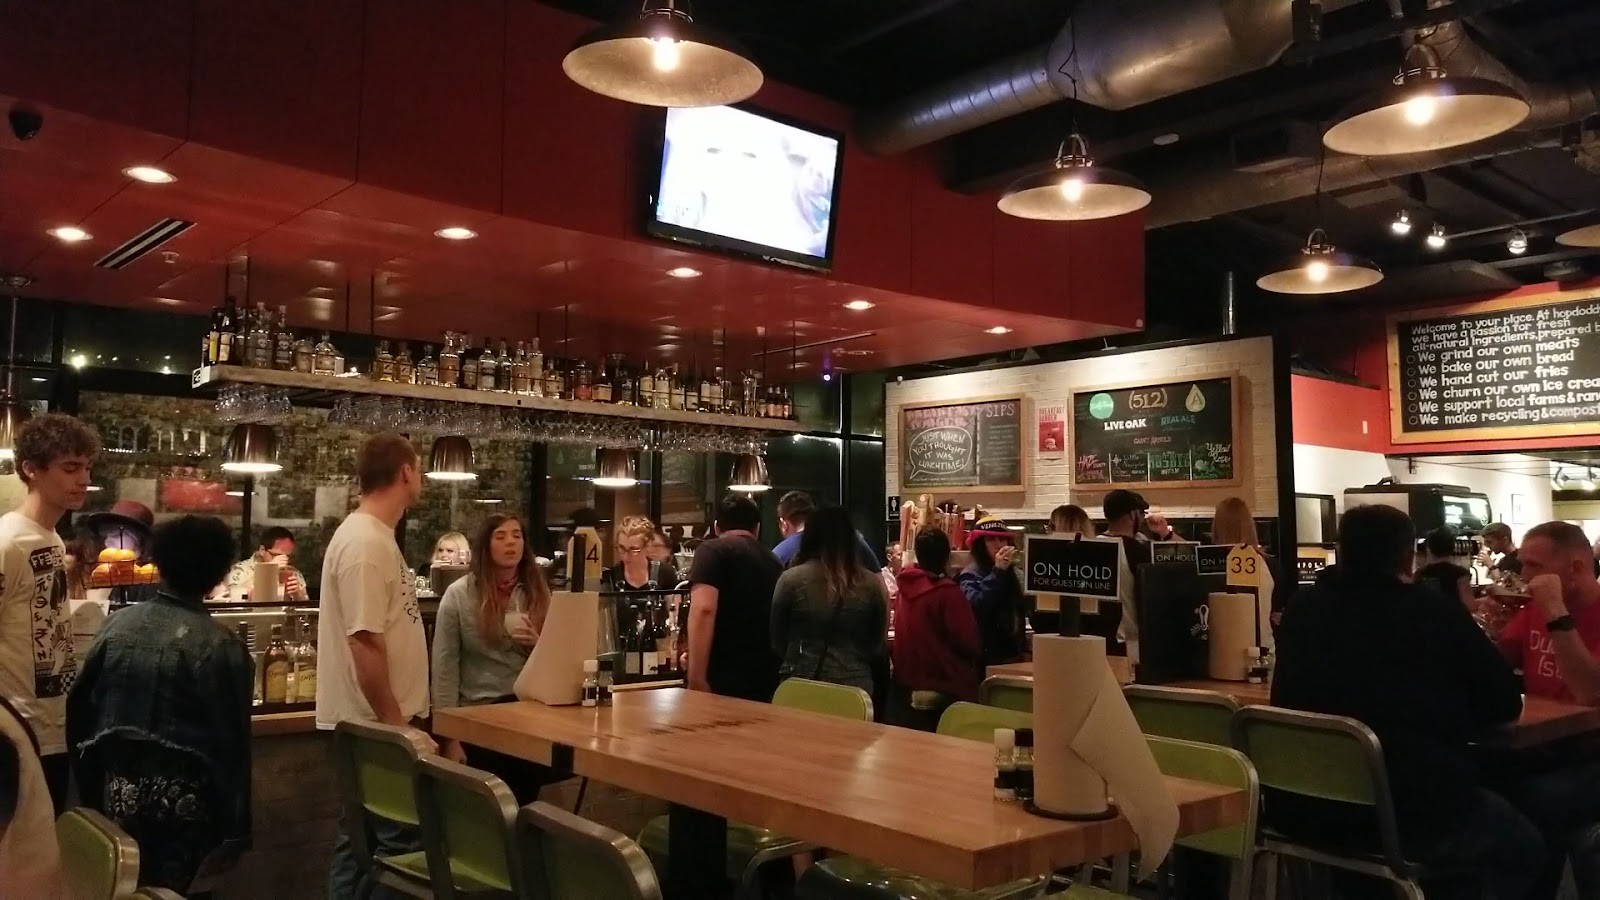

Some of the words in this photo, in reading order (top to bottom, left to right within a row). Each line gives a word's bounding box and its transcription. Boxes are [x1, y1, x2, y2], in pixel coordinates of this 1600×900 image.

[1412, 323, 1457, 335] Welcome
[1460, 320, 1473, 330] to
[1475, 318, 1501, 330] your
[1536, 309, 1550, 321] At
[1553, 303, 1600, 319] hopdodd
[1412, 334, 1430, 344] we
[1433, 331, 1458, 342] have
[1460, 330, 1468, 338] a
[1470, 324, 1510, 338] passion
[1512, 323, 1532, 332] for
[1537, 318, 1571, 330] fresh
[1412, 337, 1469, 352] all-natural
[1418, 351, 1436, 362] We
[1441, 346, 1473, 363] grind
[1476, 347, 1499, 357] our
[1503, 344, 1532, 355] own
[1535, 336, 1580, 351] meats
[1418, 364, 1437, 375] We
[1441, 361, 1473, 373] bake
[1475, 360, 1500, 370] our
[1503, 356, 1532, 367] own
[1536, 349, 1575, 365] bread
[1419, 376, 1438, 388] We
[1441, 372, 1473, 387] hand
[1476, 370, 1500, 383] cut
[1503, 370, 1529, 381] our
[1534, 365, 1569, 379] fries
[1128, 387, 1168, 410] (512)
[1419, 387, 1438, 400] We
[1443, 386, 1481, 399] churn
[1484, 385, 1508, 396] our
[1512, 382, 1540, 393] own
[986, 403, 1015, 418] SIPS
[1418, 401, 1439, 413] We
[1444, 396, 1493, 413] support
[1496, 394, 1525, 408] local
[1104, 420, 1125, 431] LIVE
[1125, 418, 1148, 429] OAK
[1161, 416, 1180, 426] REAL
[1181, 414, 1196, 424] ALE
[1418, 414, 1440, 425] We
[1444, 412, 1478, 425] make
[918, 431, 940, 446] JUST
[940, 431, 966, 444] WHEN
[912, 444, 928, 456] YOU
[928, 441, 967, 456] THOUGHT
[924, 451, 933, 460] IT
[936, 452, 953, 461] WAS
[1156, 554, 1171, 562] ON
[1173, 554, 1197, 562] HOLD
[1200, 558, 1216, 566] ON
[1231, 556, 1256, 574] 33
[1033, 562, 1061, 576] ON
[1068, 564, 1112, 580] HOLD
[1034, 577, 1049, 586] FOR
[1051, 578, 1082, 589] GUESTS
[1095, 582, 1110, 590] LINE
